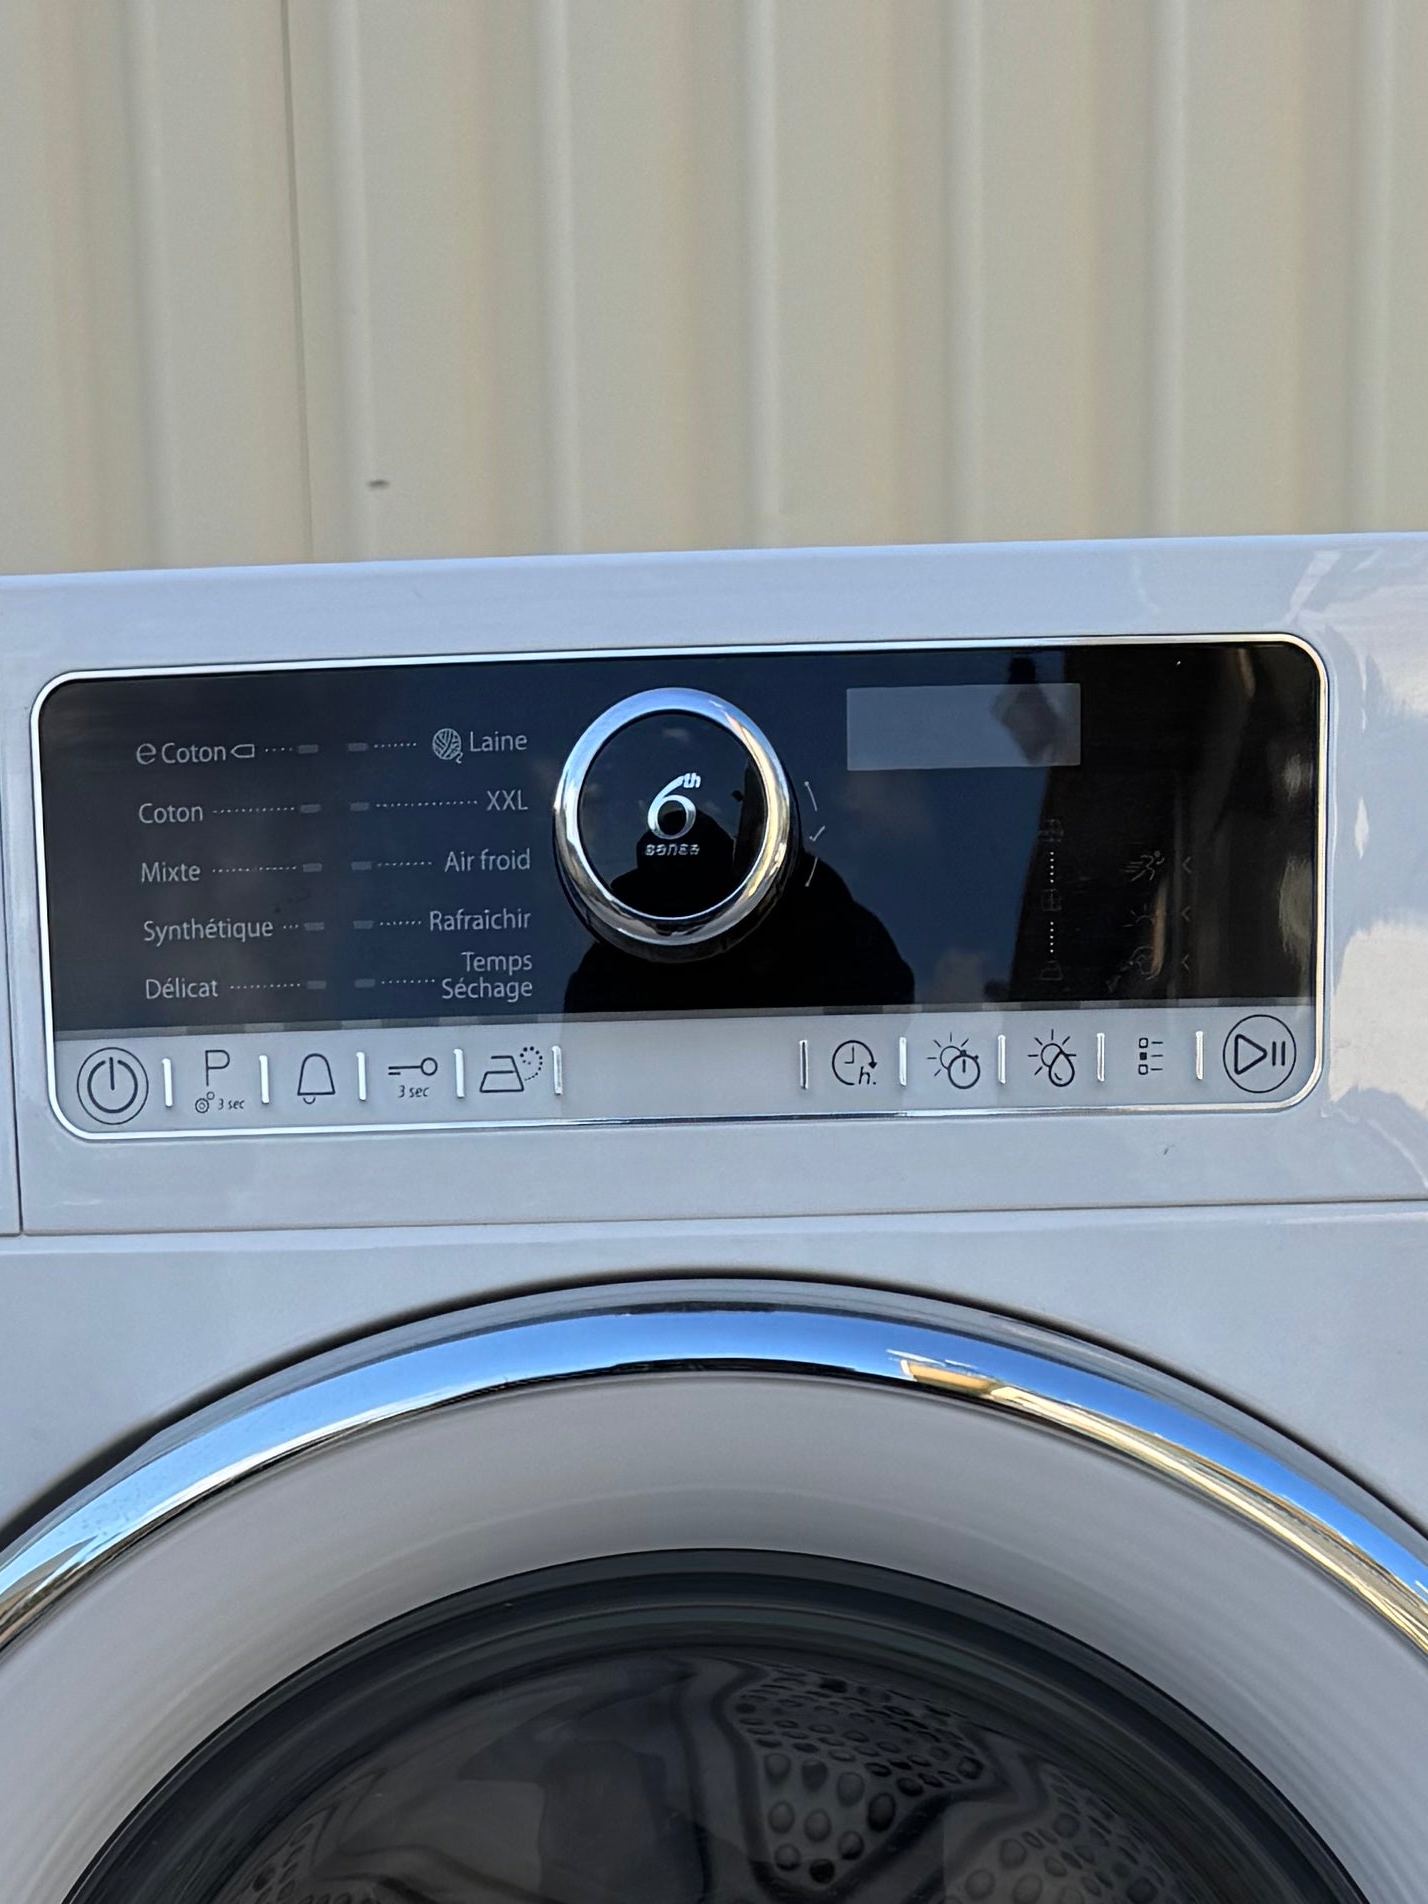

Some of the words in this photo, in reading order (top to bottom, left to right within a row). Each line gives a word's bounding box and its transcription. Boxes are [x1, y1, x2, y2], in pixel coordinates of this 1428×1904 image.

[161, 742, 226, 764] Coton
[469, 731, 528, 752] Laine
[486, 789, 529, 811] XXL
[138, 802, 204, 824] Coton
[444, 851, 475, 873] Air
[480, 847, 531, 871] froid
[140, 860, 202, 884] Mixte
[143, 917, 274, 947] Synthétique
[460, 951, 533, 976] Temps
[145, 976, 219, 1000] Délicat
[441, 976, 533, 1003] Séchage
[398, 1085, 406, 1098] 3
[408, 1085, 430, 1098] sec
[228, 1098, 245, 1110] sec
